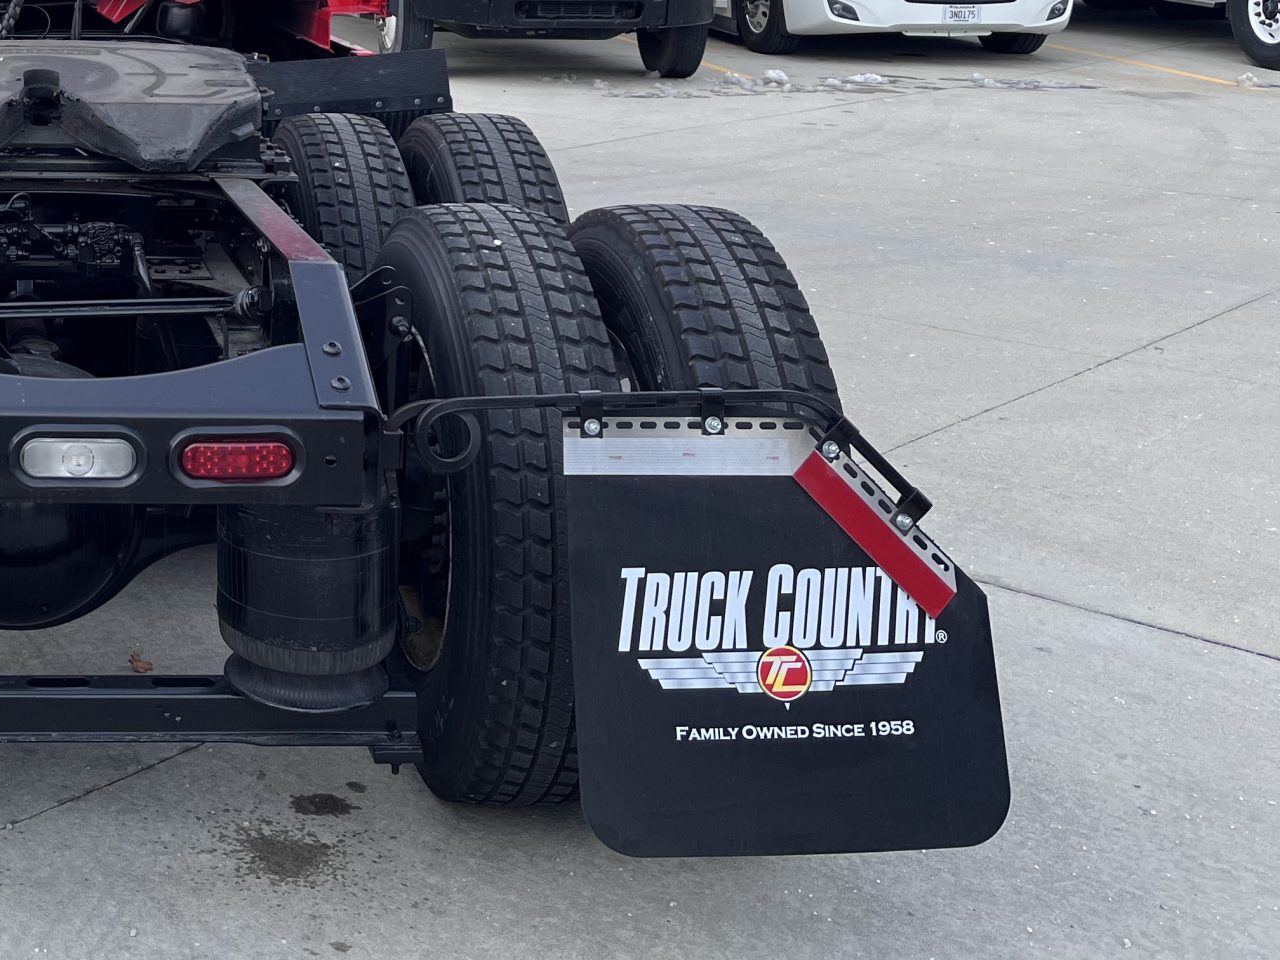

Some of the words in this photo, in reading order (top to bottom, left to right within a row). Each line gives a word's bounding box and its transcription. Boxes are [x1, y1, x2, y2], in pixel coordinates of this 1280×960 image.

[618, 566, 754, 652] TRUCK
[675, 725, 739, 741] FAMILY
[742, 724, 810, 740] OWNED
[812, 722, 865, 738] SINCE
[869, 719, 915, 737] 1958
